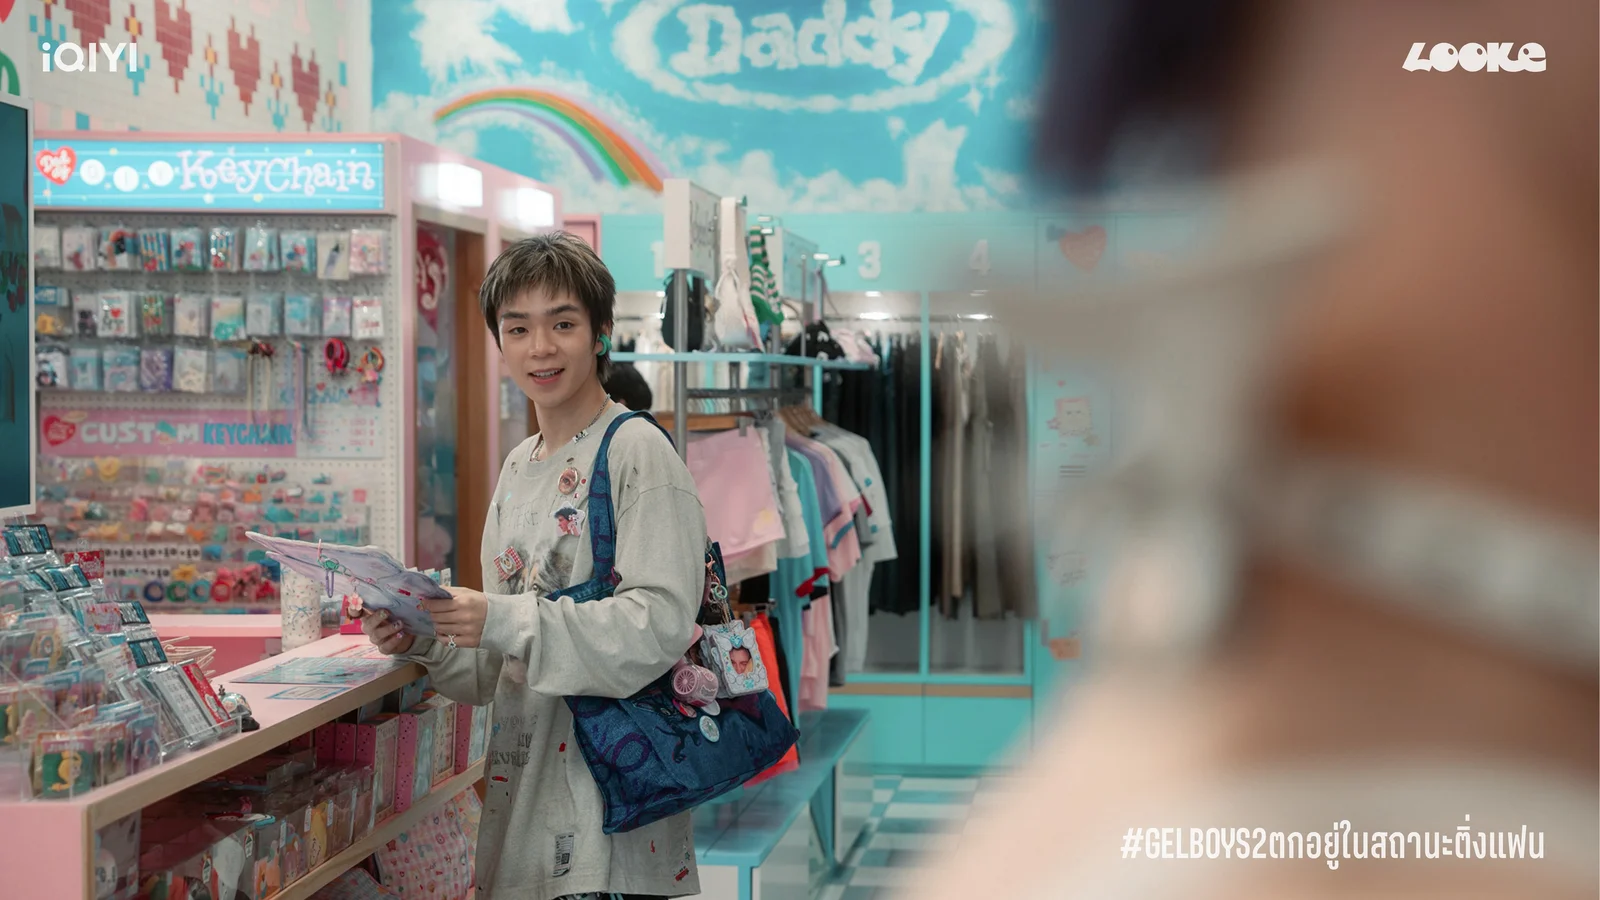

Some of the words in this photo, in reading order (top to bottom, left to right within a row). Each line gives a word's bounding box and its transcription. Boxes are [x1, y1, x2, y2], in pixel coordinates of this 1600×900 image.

[669, 0, 950, 86] Daddy
[176, 150, 375, 197] KeyChain
[857, 240, 881, 280] 3
[969, 238, 990, 275] 4
[81, 420, 199, 444] CUSTM
